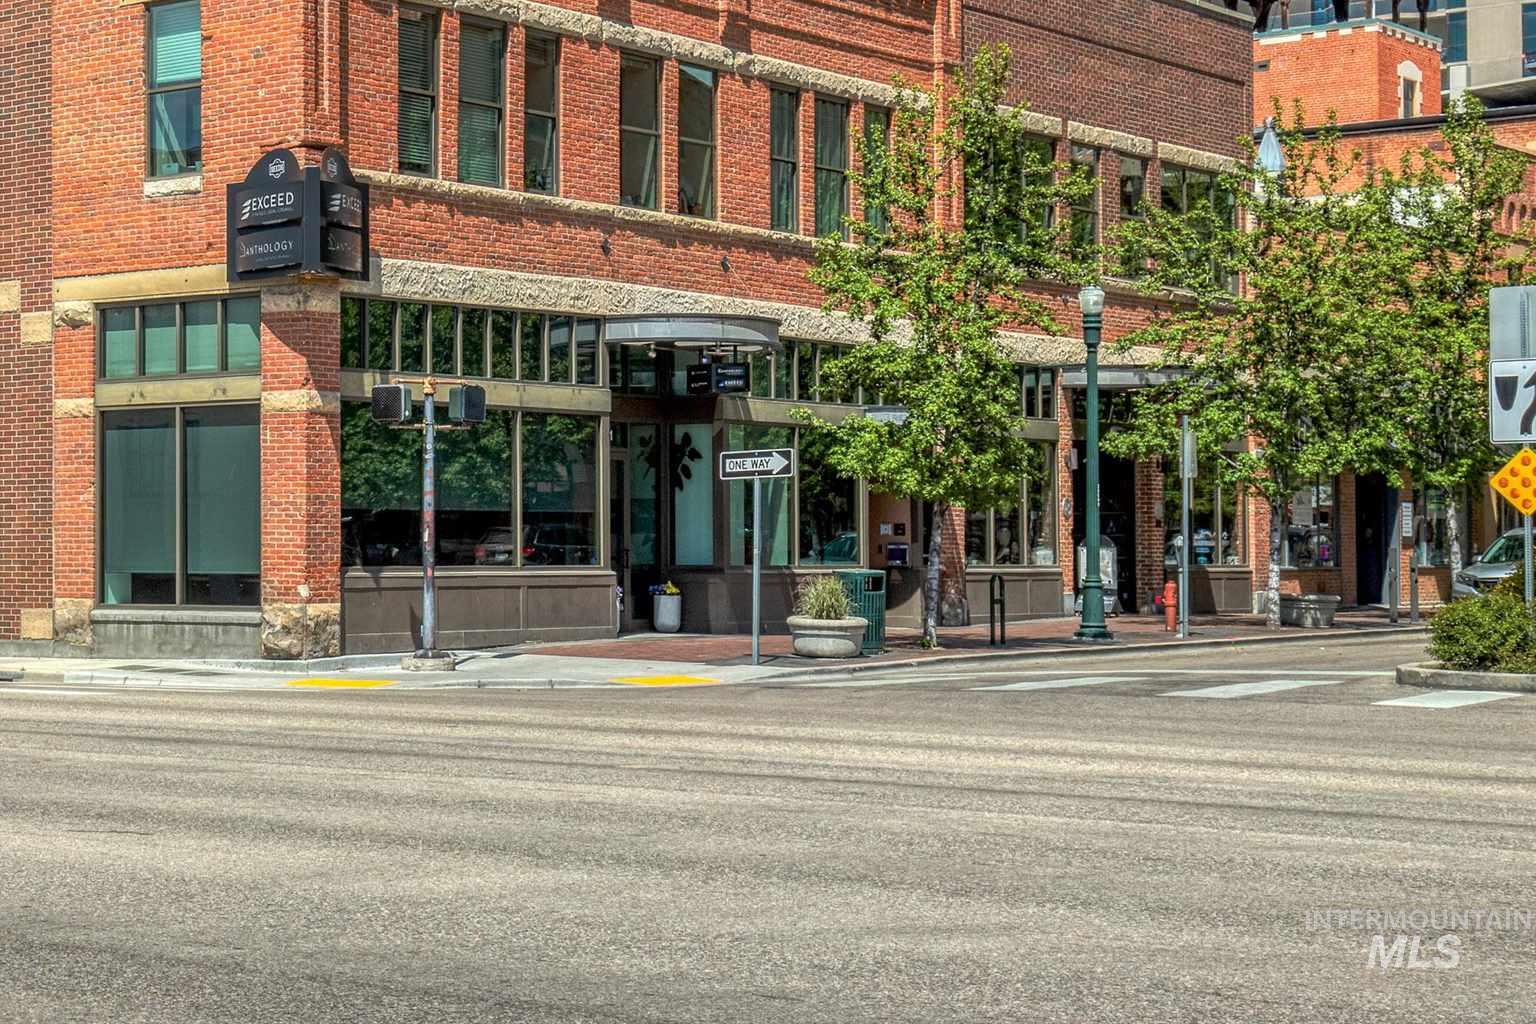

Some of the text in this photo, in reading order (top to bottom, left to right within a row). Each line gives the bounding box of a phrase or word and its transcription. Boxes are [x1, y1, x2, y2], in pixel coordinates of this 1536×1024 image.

[251, 191, 295, 211] EXCEED
[245, 240, 295, 256] ANTHOLOGY
[728, 458, 772, 471] ONE WAY
